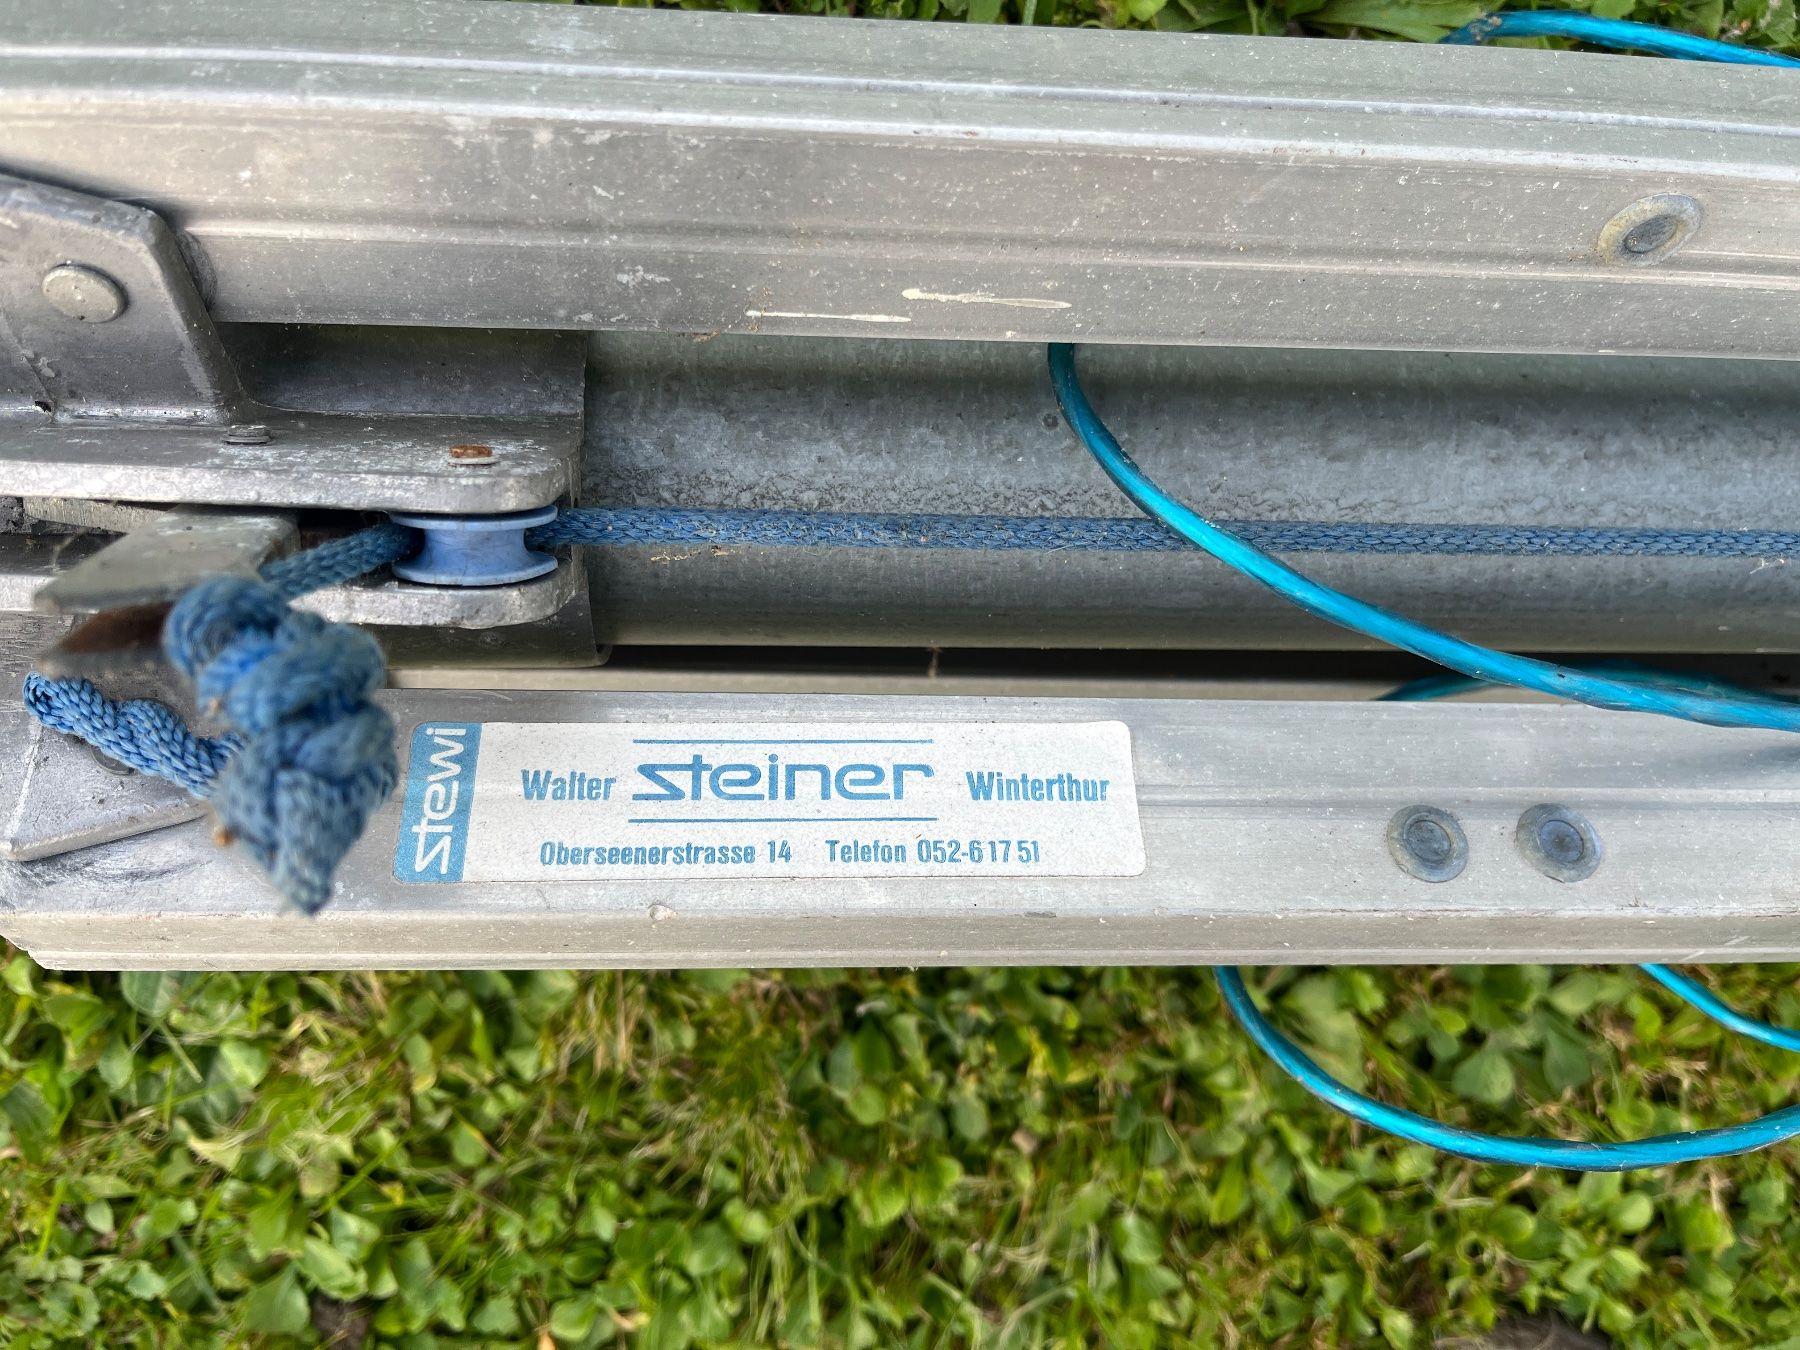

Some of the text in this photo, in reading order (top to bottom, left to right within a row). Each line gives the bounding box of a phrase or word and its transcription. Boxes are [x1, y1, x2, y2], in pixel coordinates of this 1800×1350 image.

[412, 727, 467, 876] stewi
[520, 754, 1110, 802] Walter steiner Winterthur
[540, 840, 756, 866] Oberseenerstrasse
[767, 840, 793, 864] 14
[825, 840, 907, 864] Telefon
